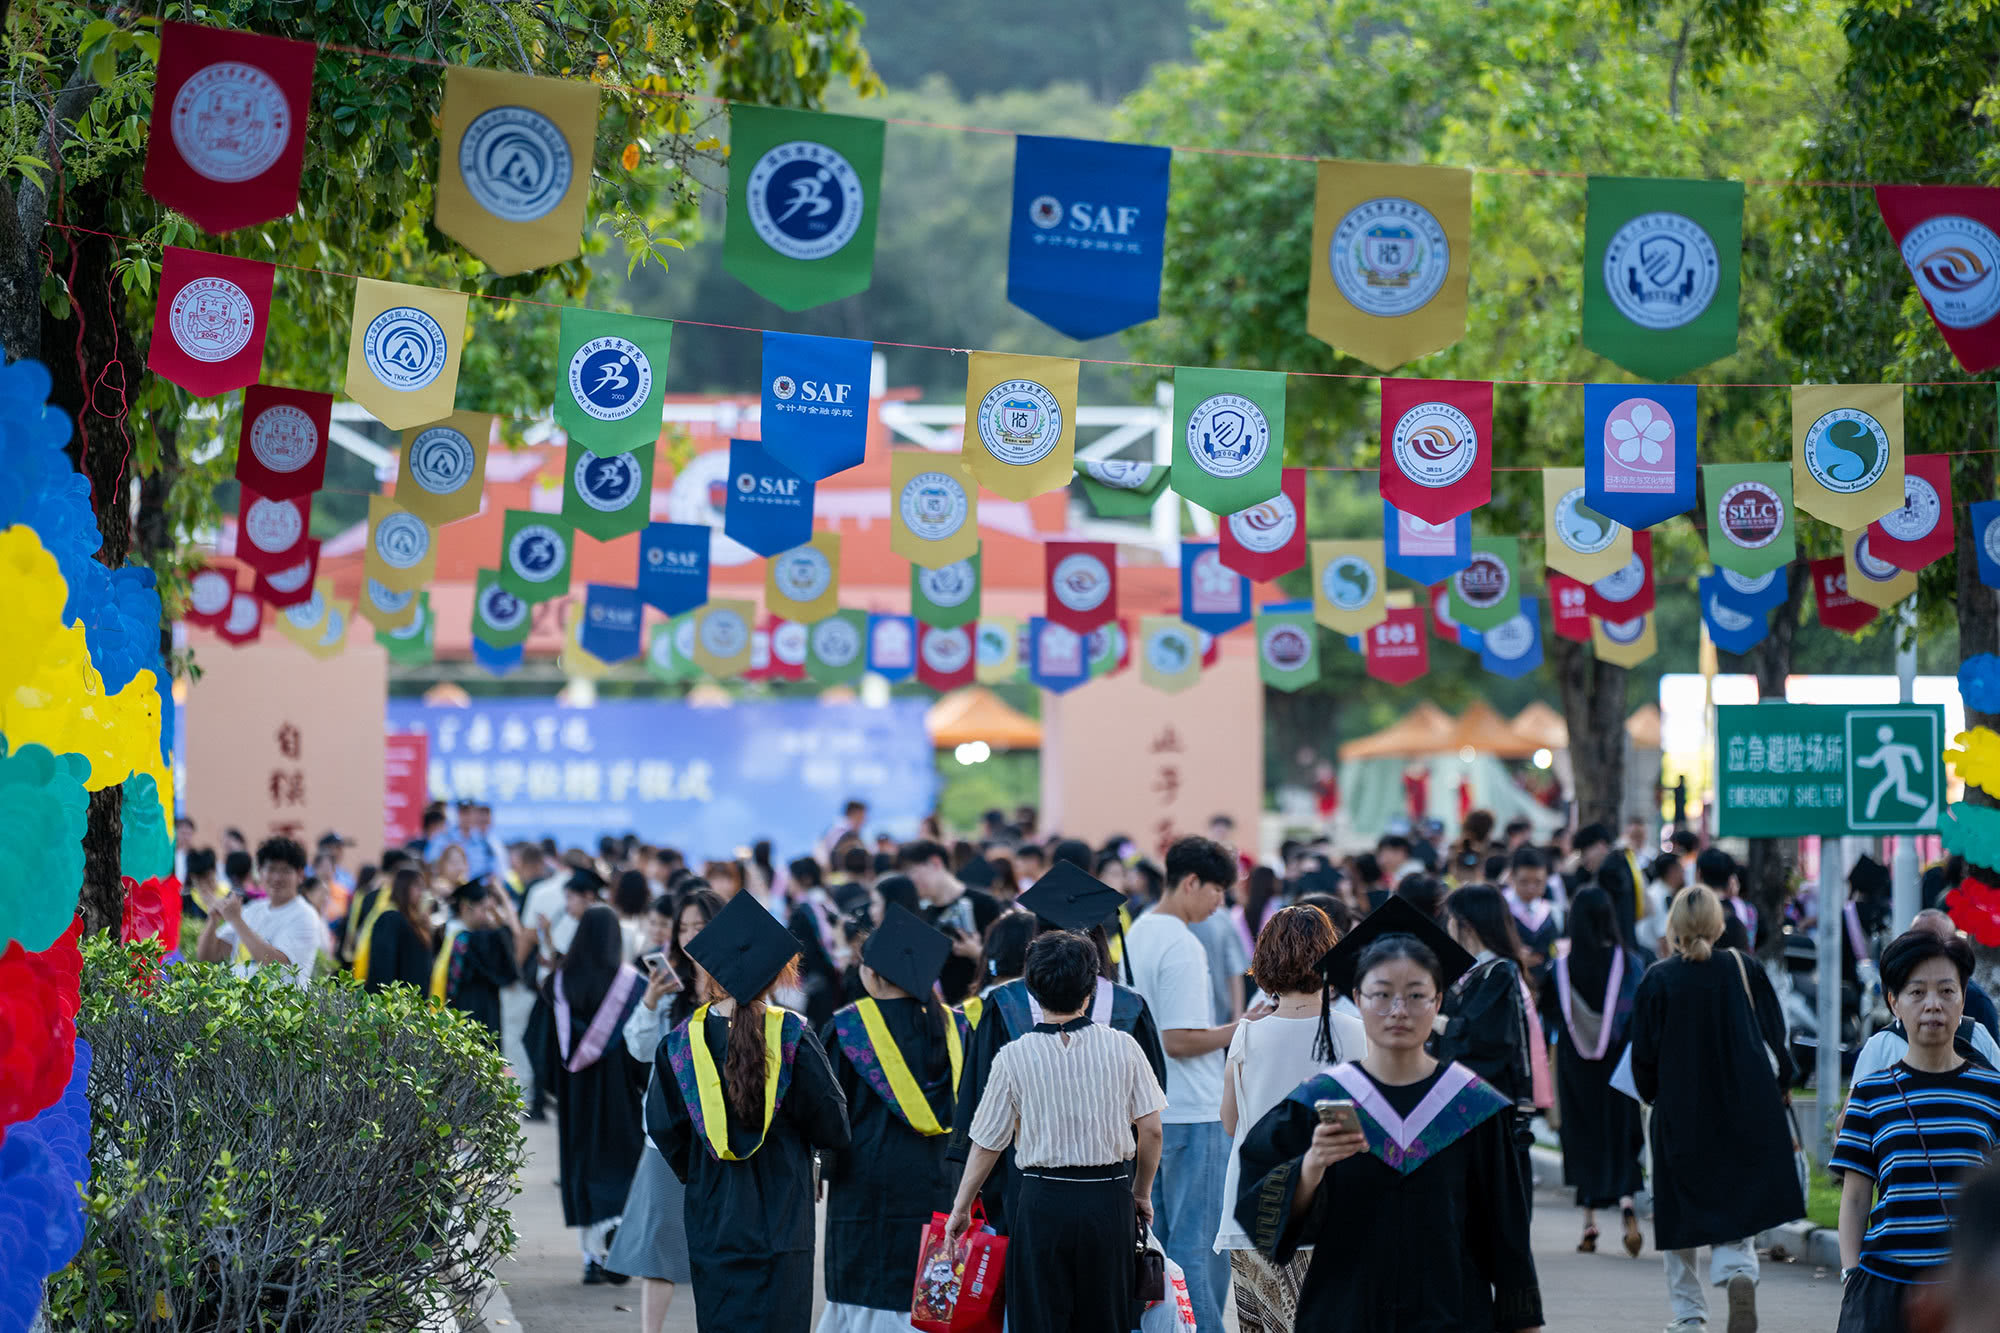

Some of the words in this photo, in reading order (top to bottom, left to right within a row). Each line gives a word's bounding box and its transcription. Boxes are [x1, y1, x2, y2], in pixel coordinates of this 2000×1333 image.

[1069, 202, 1140, 234] SAF
[801, 380, 851, 404] SAF
[759, 477, 800, 496] SAF
[1729, 503, 1773, 519] SELC
[665, 551, 699, 568] SAF
[1727, 734, 1843, 773] 应急避险场所
[1727, 784, 1789, 808] EMERGENCY
[1796, 784, 1844, 808] SHELTER
